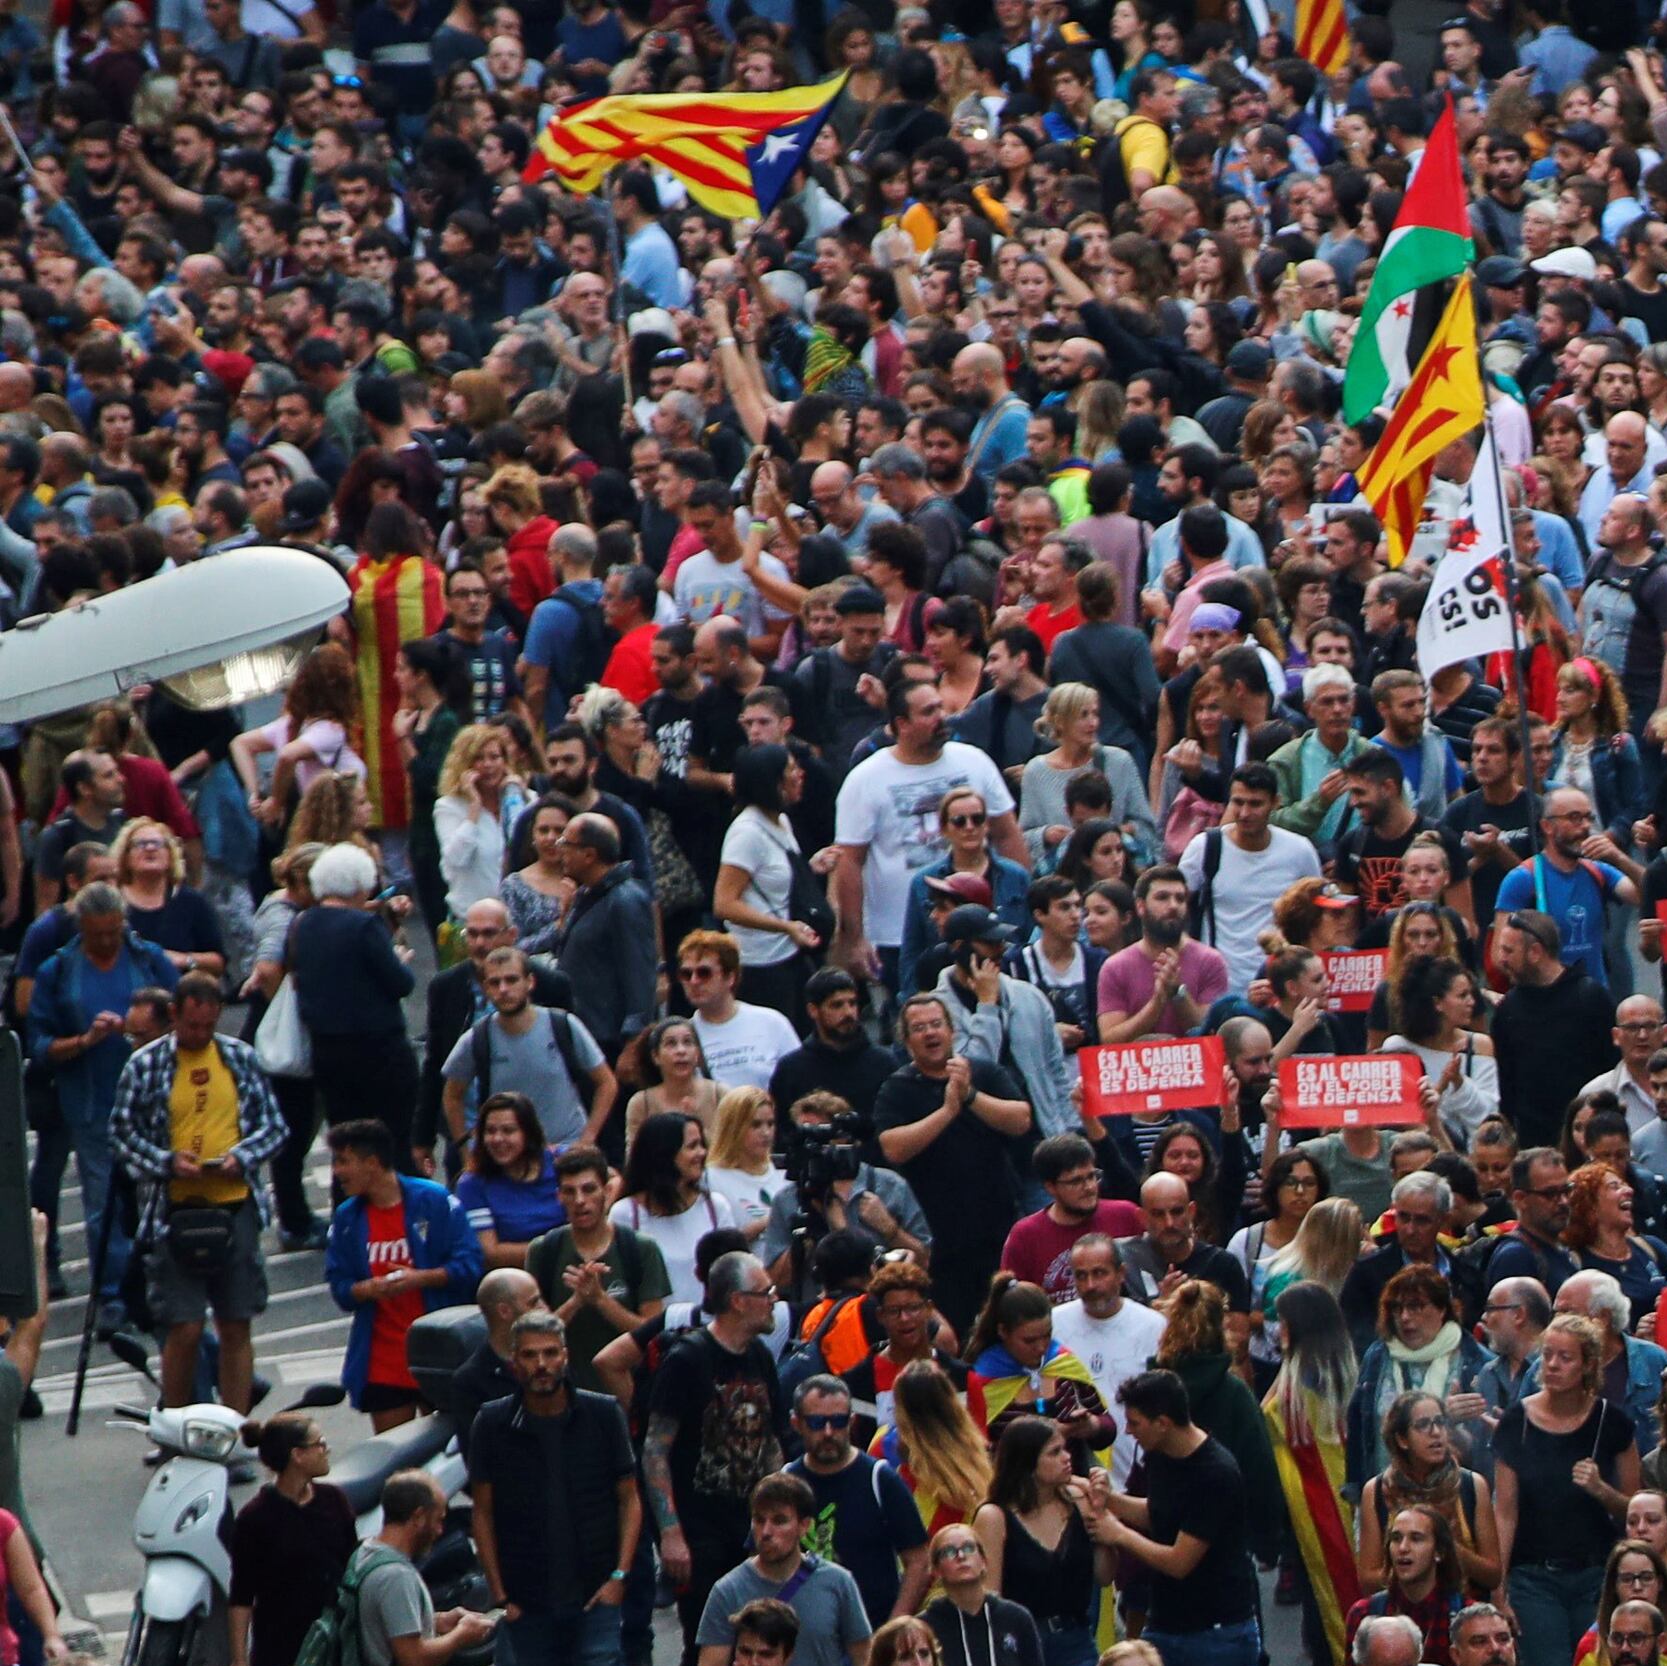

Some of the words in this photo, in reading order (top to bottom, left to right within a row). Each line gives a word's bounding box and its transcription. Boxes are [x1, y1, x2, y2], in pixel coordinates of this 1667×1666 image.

[1465, 566, 1500, 622] OS
[1439, 587, 1467, 633] CS!
[1121, 1050, 1139, 1068] AL
[1143, 1044, 1201, 1066] CARRER
[1098, 1067, 1125, 1083] ON
[1129, 1064, 1148, 1080] EL
[1152, 1058, 1204, 1077] POBLE
[1321, 1064, 1338, 1080] AL
[1343, 1061, 1400, 1080] CARRER
[1100, 1080, 1123, 1096] ES
[1127, 1072, 1204, 1093] DEFENSA
[1297, 1080, 1323, 1094] ON
[1327, 1079, 1346, 1093] EL
[1351, 1076, 1402, 1092] POBLE
[1299, 1094, 1320, 1108] ES
[1325, 1090, 1401, 1106] DEFENSA
